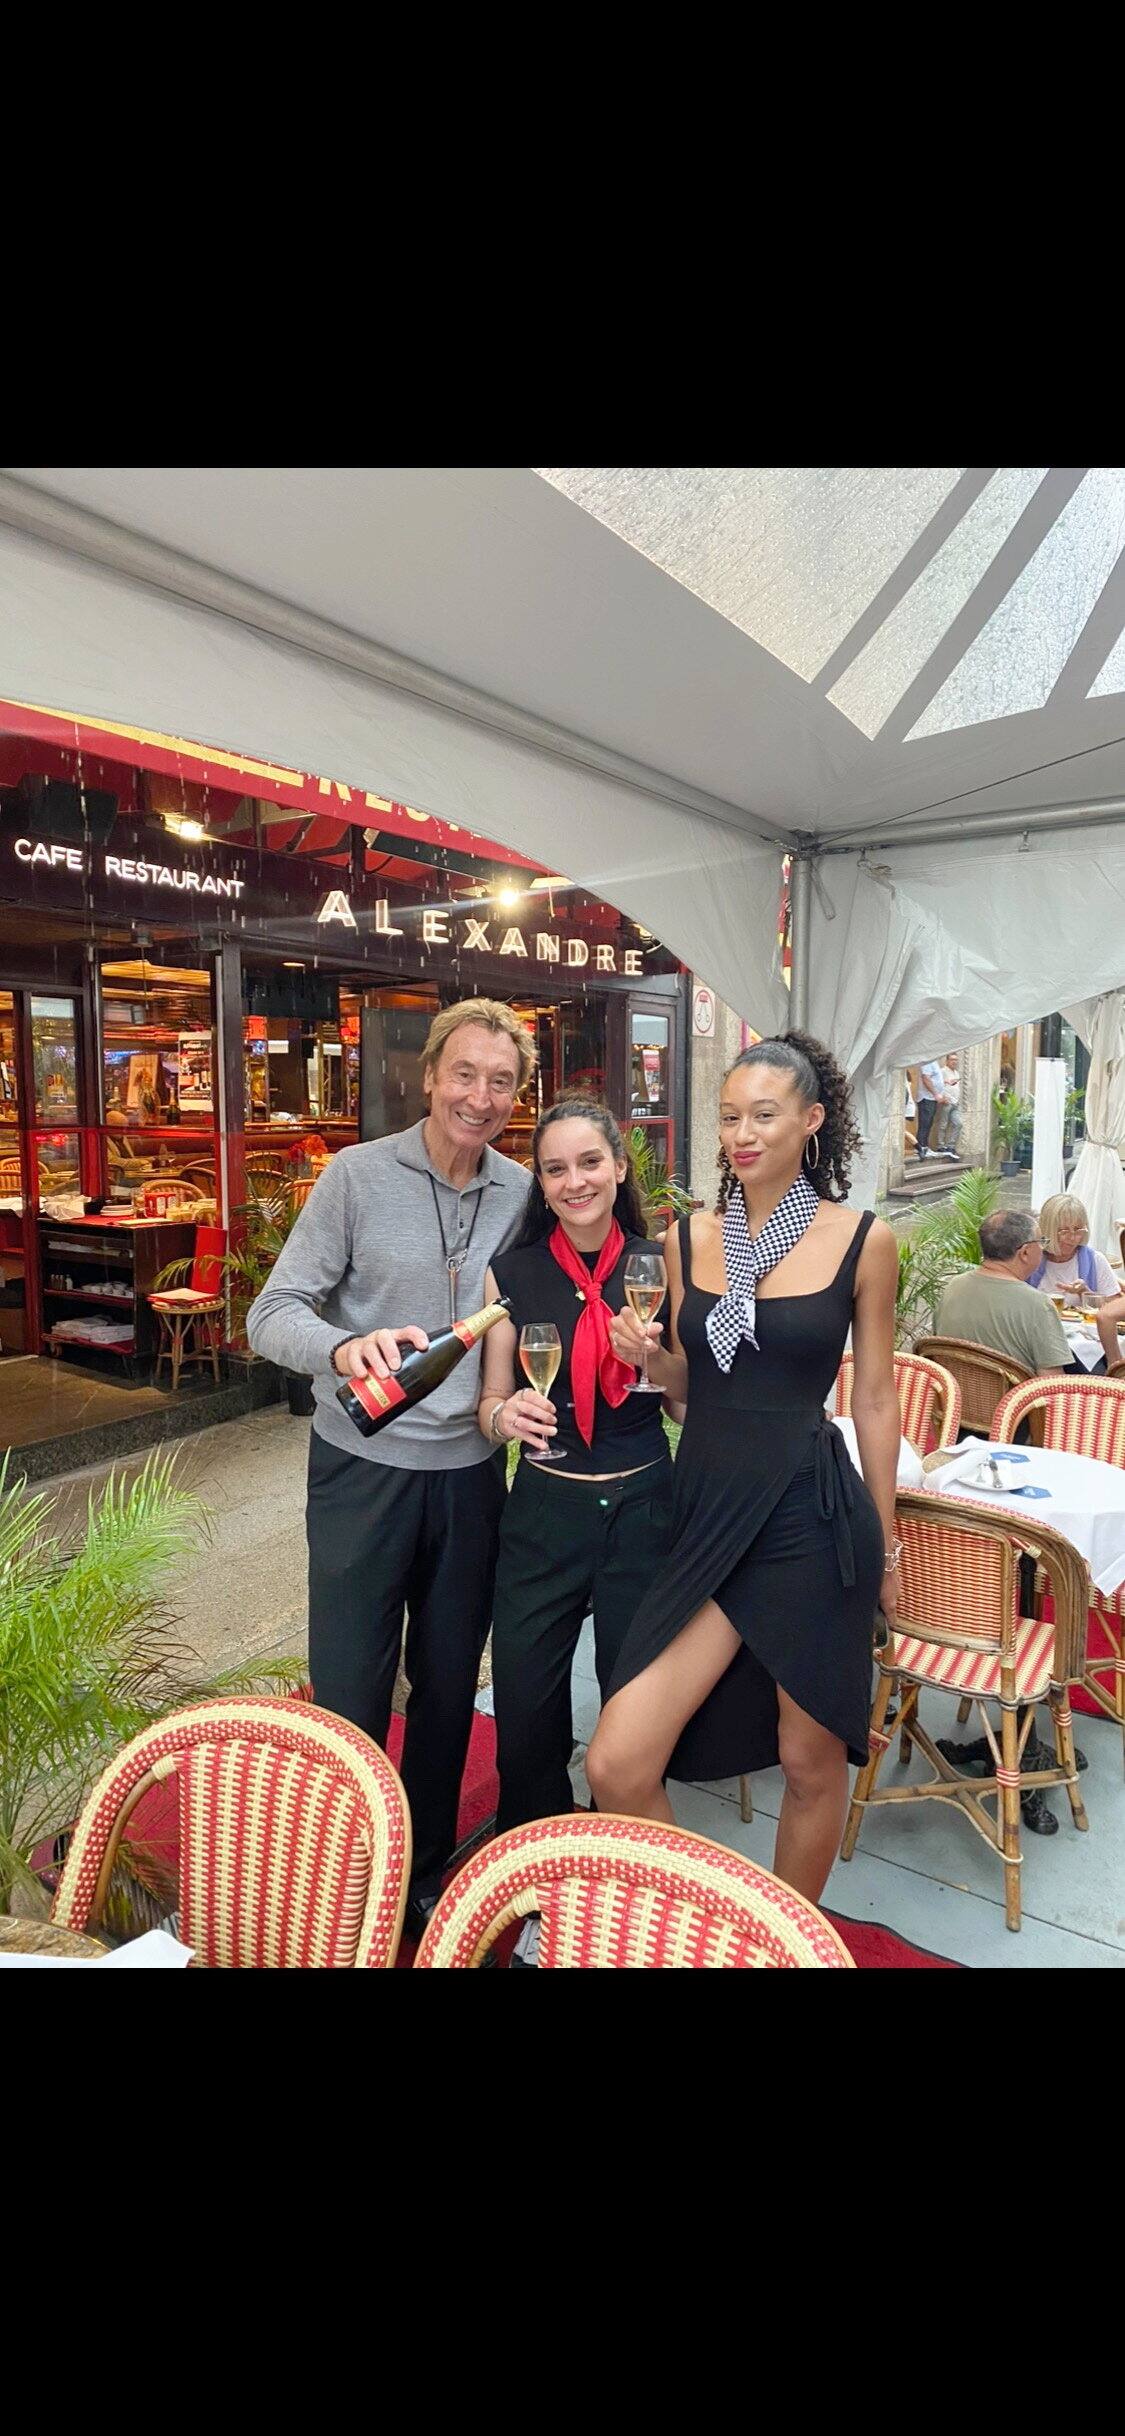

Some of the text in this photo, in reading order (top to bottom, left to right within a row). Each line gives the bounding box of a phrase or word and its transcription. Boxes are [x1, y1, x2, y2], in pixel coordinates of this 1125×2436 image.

[14, 838, 245, 898] CAFE RESTAURANT
[316, 889, 645, 976] ALEXANDRE
